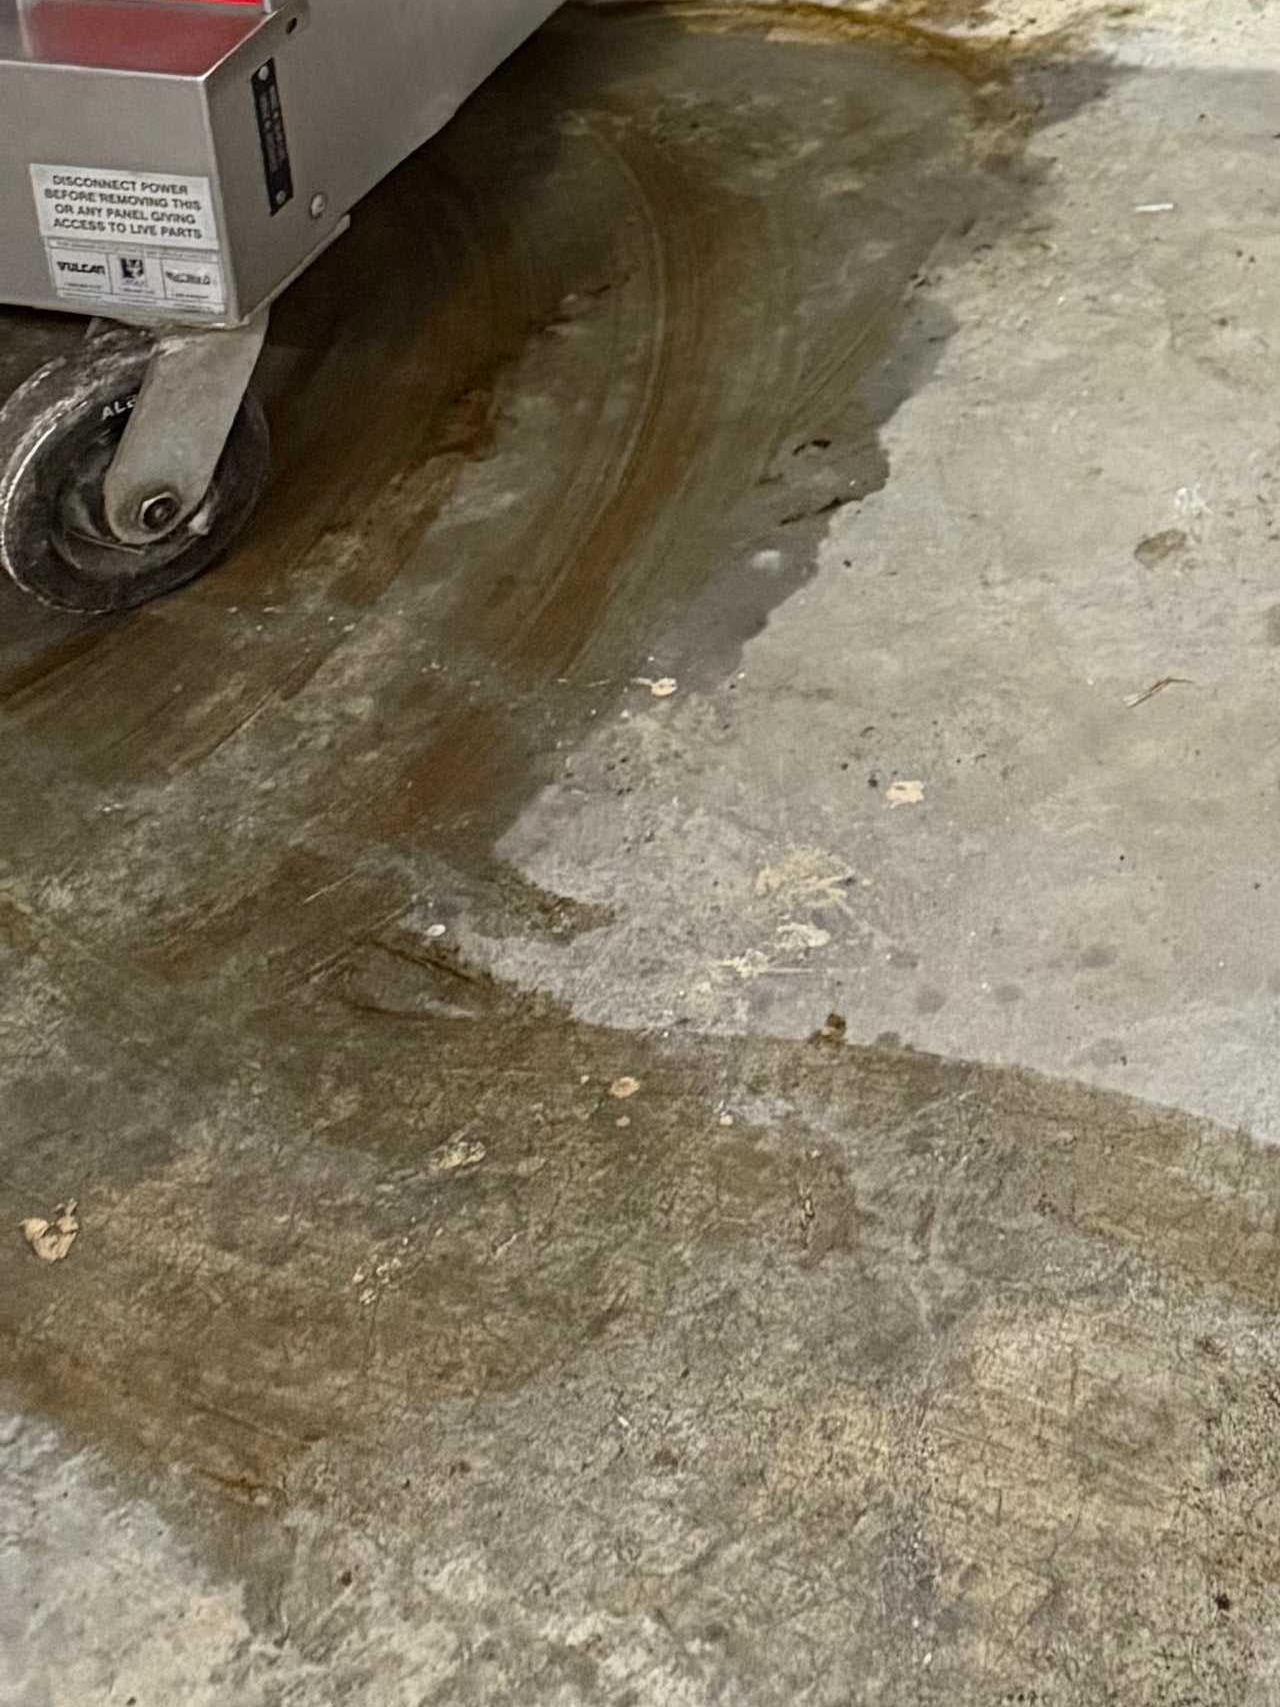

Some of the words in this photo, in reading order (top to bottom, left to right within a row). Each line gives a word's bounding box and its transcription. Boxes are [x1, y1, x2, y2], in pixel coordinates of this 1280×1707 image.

[53, 175, 138, 192] DISCONNECT
[141, 181, 188, 195] POWER
[44, 188, 95, 202] BEFORE
[98, 192, 168, 208] REMOVING
[172, 198, 202, 211] THIS
[54, 203, 73, 214] OR
[76, 205, 102, 217] ANY
[106, 208, 148, 221] PANEL
[151, 211, 196, 225] GIVING
[53, 218, 106, 232] ACCESS
[108, 222, 126, 234] TO
[129, 224, 158, 237] LIVE
[160, 227, 202, 239] PARTS
[57, 261, 106, 275] VULCAN
